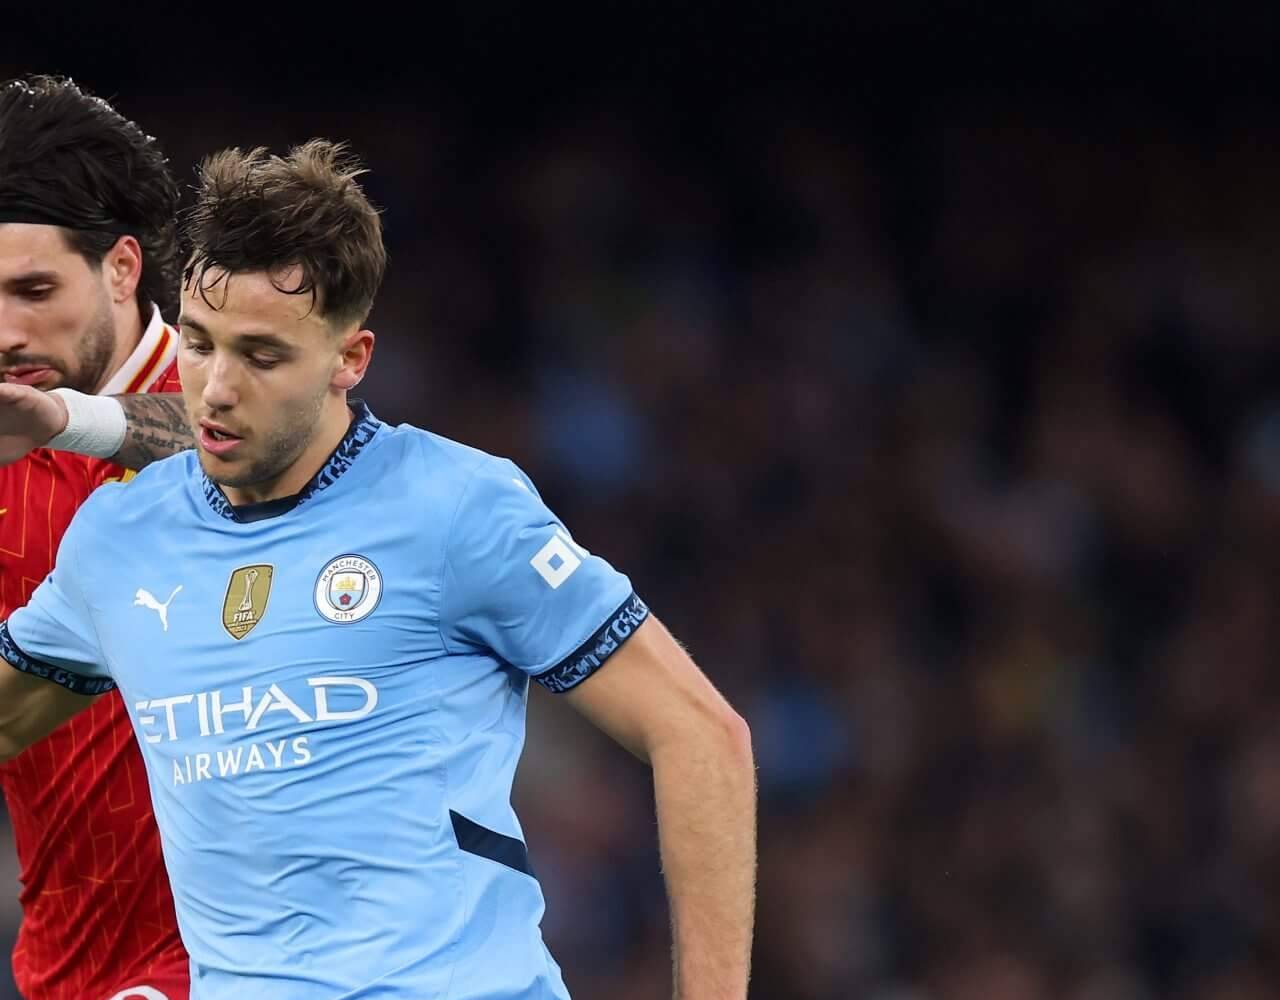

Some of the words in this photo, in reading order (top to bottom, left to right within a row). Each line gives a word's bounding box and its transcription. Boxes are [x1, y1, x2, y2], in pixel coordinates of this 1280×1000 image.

[322, 560, 376, 581] MANCHESTER
[233, 610, 254, 622] FIFA
[334, 612, 355, 620] CITY
[136, 676, 378, 743] ETIHAD
[173, 737, 312, 786] AIRWAYS
